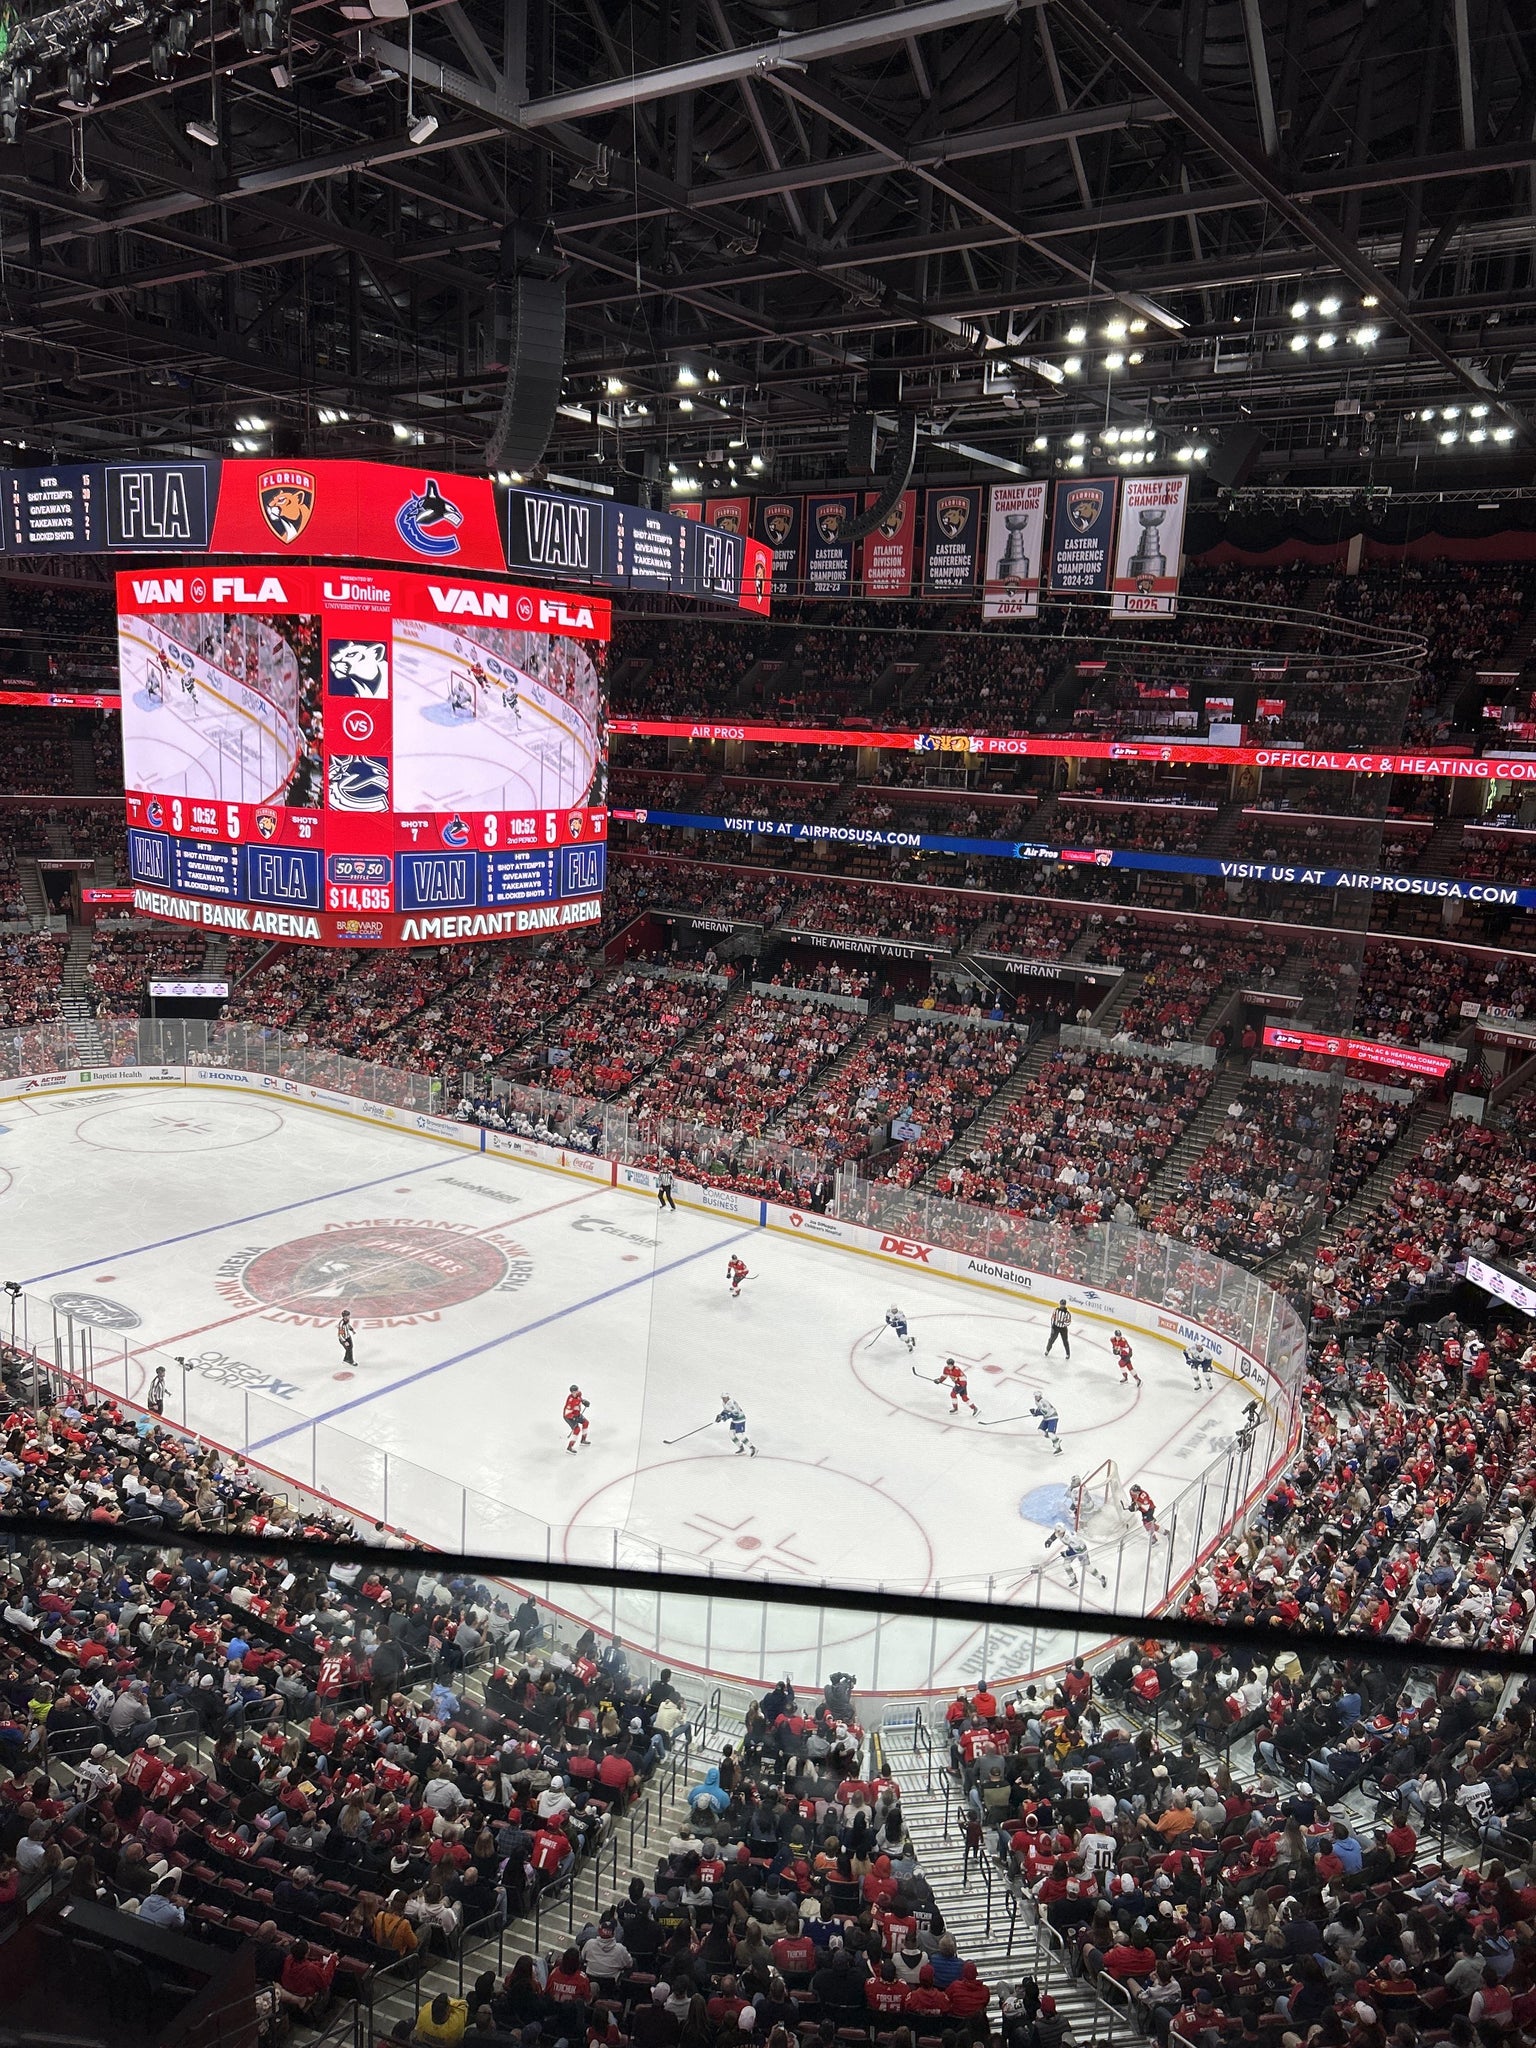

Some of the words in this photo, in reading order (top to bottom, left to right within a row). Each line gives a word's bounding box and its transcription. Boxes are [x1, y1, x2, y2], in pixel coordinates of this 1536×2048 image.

[40, 477, 57, 488] HITS
[263, 472, 310, 487] FLORIDA
[994, 488, 1026, 501] STANLEY
[1027, 487, 1043, 499] CUP
[1127, 482, 1163, 495] STANLEY
[1165, 481, 1183, 493] CUP
[28, 492, 43, 502] SHOT
[43, 490, 73, 501] ATTEMPTS
[1128, 494, 1179, 507] CHAMPIONS
[30, 504, 71, 515] GIVEAWAYS
[84, 502, 90, 513] 7
[120, 472, 190, 538] FLA
[995, 499, 1039, 512] CHAMPIONS
[30, 518, 73, 529] TAKEAWAYS
[84, 516, 90, 527] 2
[29, 532, 55, 542] BLOCKED
[55, 531, 74, 541] SHOTS
[525, 497, 590, 569] VAN
[634, 544, 671, 557] GIVEAWAYS
[873, 545, 904, 556] ATLANTIC
[936, 544, 966, 555] EASTERN
[1064, 538, 1098, 550] EASTERN
[815, 549, 843, 560] EASTERN
[873, 556, 902, 567] DIVISION
[929, 555, 971, 567] CONFERENCE
[1057, 550, 1104, 562] CONFERENCE
[634, 556, 672, 569] TAKEAWAYS
[703, 533, 736, 594] FLA
[810, 560, 848, 570] CONFERENCE
[1057, 562, 1102, 574] CHAMPIONS
[810, 570, 847, 581] CHAMPIONS
[868, 568, 906, 578] CHAMPIONS
[930, 566, 969, 577] CHAMPIONS
[1062, 575, 1094, 586] 2024-25
[132, 579, 184, 604] VAN
[193, 586, 204, 596] VS
[212, 577, 289, 603] FLA
[325, 603, 361, 611] UNIVERSITY
[362, 604, 370, 612] OF
[371, 605, 391, 613] MIAMI
[427, 586, 508, 619] VAN
[520, 604, 530, 614] VS
[539, 598, 595, 630] FLA
[997, 599, 1023, 614] 2024
[1129, 598, 1158, 612] 2025
[691, 727, 711, 737] AIR
[714, 728, 745, 739] PROS
[989, 741, 1027, 753] PROS
[1256, 751, 1340, 769] OFFICIAL
[1345, 757, 1373, 771] AC
[1379, 758, 1393, 772] &
[1400, 759, 1489, 777] HEATING
[172, 799, 183, 832] 3
[192, 807, 217, 825] 10:52
[227, 805, 240, 839] 5
[292, 816, 319, 825] SHOTS
[401, 820, 429, 829] SHOTS
[484, 814, 498, 847] 3
[510, 817, 536, 835] 10:52
[545, 812, 557, 843] 5
[299, 825, 312, 839] 20
[411, 828, 419, 842] 7
[724, 817, 755, 831] VISIT
[757, 821, 774, 833] US
[776, 823, 793, 834] AT
[800, 824, 921, 847] AIRPROSUSA.COM
[134, 837, 164, 880] VAN
[514, 852, 530, 861] HITS
[1024, 847, 1038, 856] Air
[1039, 848, 1059, 859] Pros
[188, 862, 223, 873] GIVEAWAYS
[336, 862, 353, 875] 50
[367, 863, 384, 875] 50
[497, 863, 514, 871] SHOT
[514, 861, 546, 871] ATTEMPTS
[568, 850, 598, 889] FLA
[187, 871, 225, 883] TAKEAWAYS
[259, 853, 307, 899] FLA
[413, 860, 466, 902] VAN
[502, 871, 541, 881] GIVEAWAYS
[501, 880, 542, 890] TAKEAWAYS
[1220, 862, 1266, 879] VISIT
[1271, 867, 1295, 881] US
[1300, 870, 1326, 884] AT
[1336, 873, 1518, 905] AIRPROSUSA.COM
[329, 888, 390, 912] $14,635
[497, 891, 524, 901] BLOCKED
[525, 890, 545, 898] SHOTS
[134, 888, 202, 922] AMERANT
[203, 904, 251, 930] BANK
[252, 911, 321, 939] ARENA
[400, 911, 516, 941] AMERANT
[517, 905, 561, 930] BANK
[560, 899, 602, 925] ARENA
[691, 920, 734, 933] AMERANT
[810, 936, 827, 948] THE
[829, 940, 878, 955] AMERANT
[880, 945, 915, 960] VAULT
[1004, 962, 1062, 979] AMERANT
[1286, 1001, 1299, 1009] 104
[1484, 1032, 1499, 1042] 104
[1348, 1042, 1372, 1054] OFFICIAL
[1391, 1050, 1417, 1063] HEATING
[1418, 1055, 1450, 1069] COMPANY
[1358, 1051, 1367, 1059] OF
[1368, 1053, 1380, 1062] THE
[1380, 1056, 1406, 1068] FLORIDA
[1406, 1061, 1438, 1074] PANTHERS
[41, 1075, 67, 1083] ACTION
[93, 1072, 118, 1081] Baptist
[118, 1070, 143, 1079] Health
[209, 1072, 249, 1083] HONDA
[436, 1176, 522, 1203] AutoNation
[702, 1188, 738, 1204] COMCAST
[702, 1196, 738, 1212] BUSINESS
[322, 1217, 477, 1233] AMERANT
[600, 1226, 663, 1247] CELSIUS
[485, 1233, 531, 1258] BANK
[880, 1236, 934, 1263] DEX
[365, 1239, 467, 1277] PANTHERS
[493, 1258, 535, 1292] ARENA
[968, 1260, 1032, 1287] AutoNation
[61, 1298, 125, 1324] Ford
[1178, 1325, 1223, 1356] AMAZING
[1449, 1347, 1461, 1359] 63
[188, 1357, 254, 1389] SPORT
[200, 1351, 273, 1384] OMEGA
[1251, 1368, 1266, 1388] App
[245, 1378, 304, 1400] XL
[321, 1662, 342, 1683] 72
[539, 1847, 549, 1868] 1
[1094, 1850, 1112, 1870] 10
